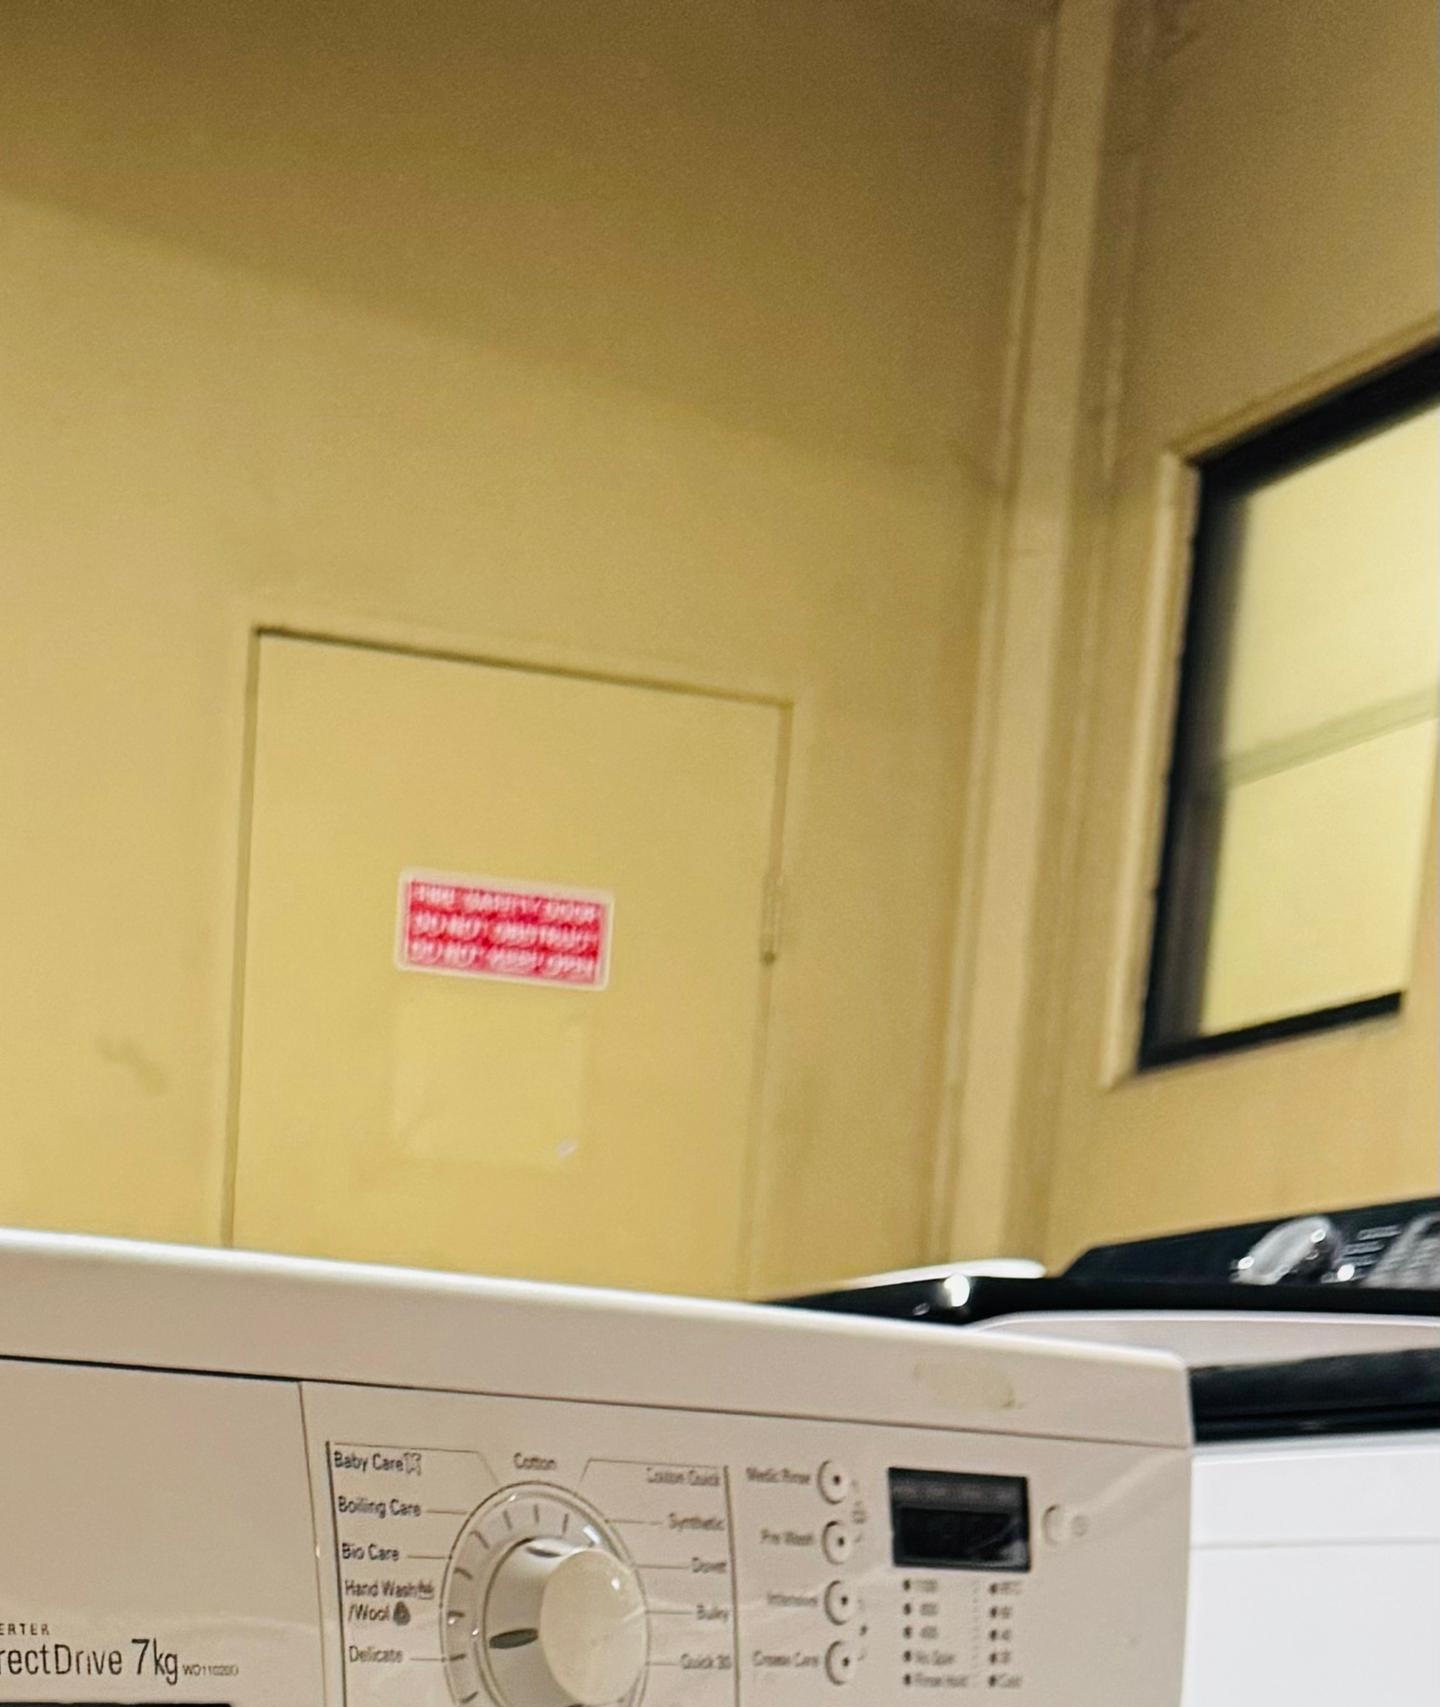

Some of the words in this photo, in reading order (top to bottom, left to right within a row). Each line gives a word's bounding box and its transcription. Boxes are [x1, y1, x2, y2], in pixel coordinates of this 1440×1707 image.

[334, 1450, 368, 1473] Baby
[372, 1452, 404, 1471] Care
[338, 1495, 386, 1519] Boiling
[390, 1498, 421, 1517] Care
[342, 1542, 364, 1560] Bio
[367, 1543, 400, 1562] Care
[345, 1580, 379, 1597] Hand
[381, 1580, 417, 1598] Wash
[131, 1637, 179, 1686] 7kg
[349, 1645, 404, 1664] Delicate
